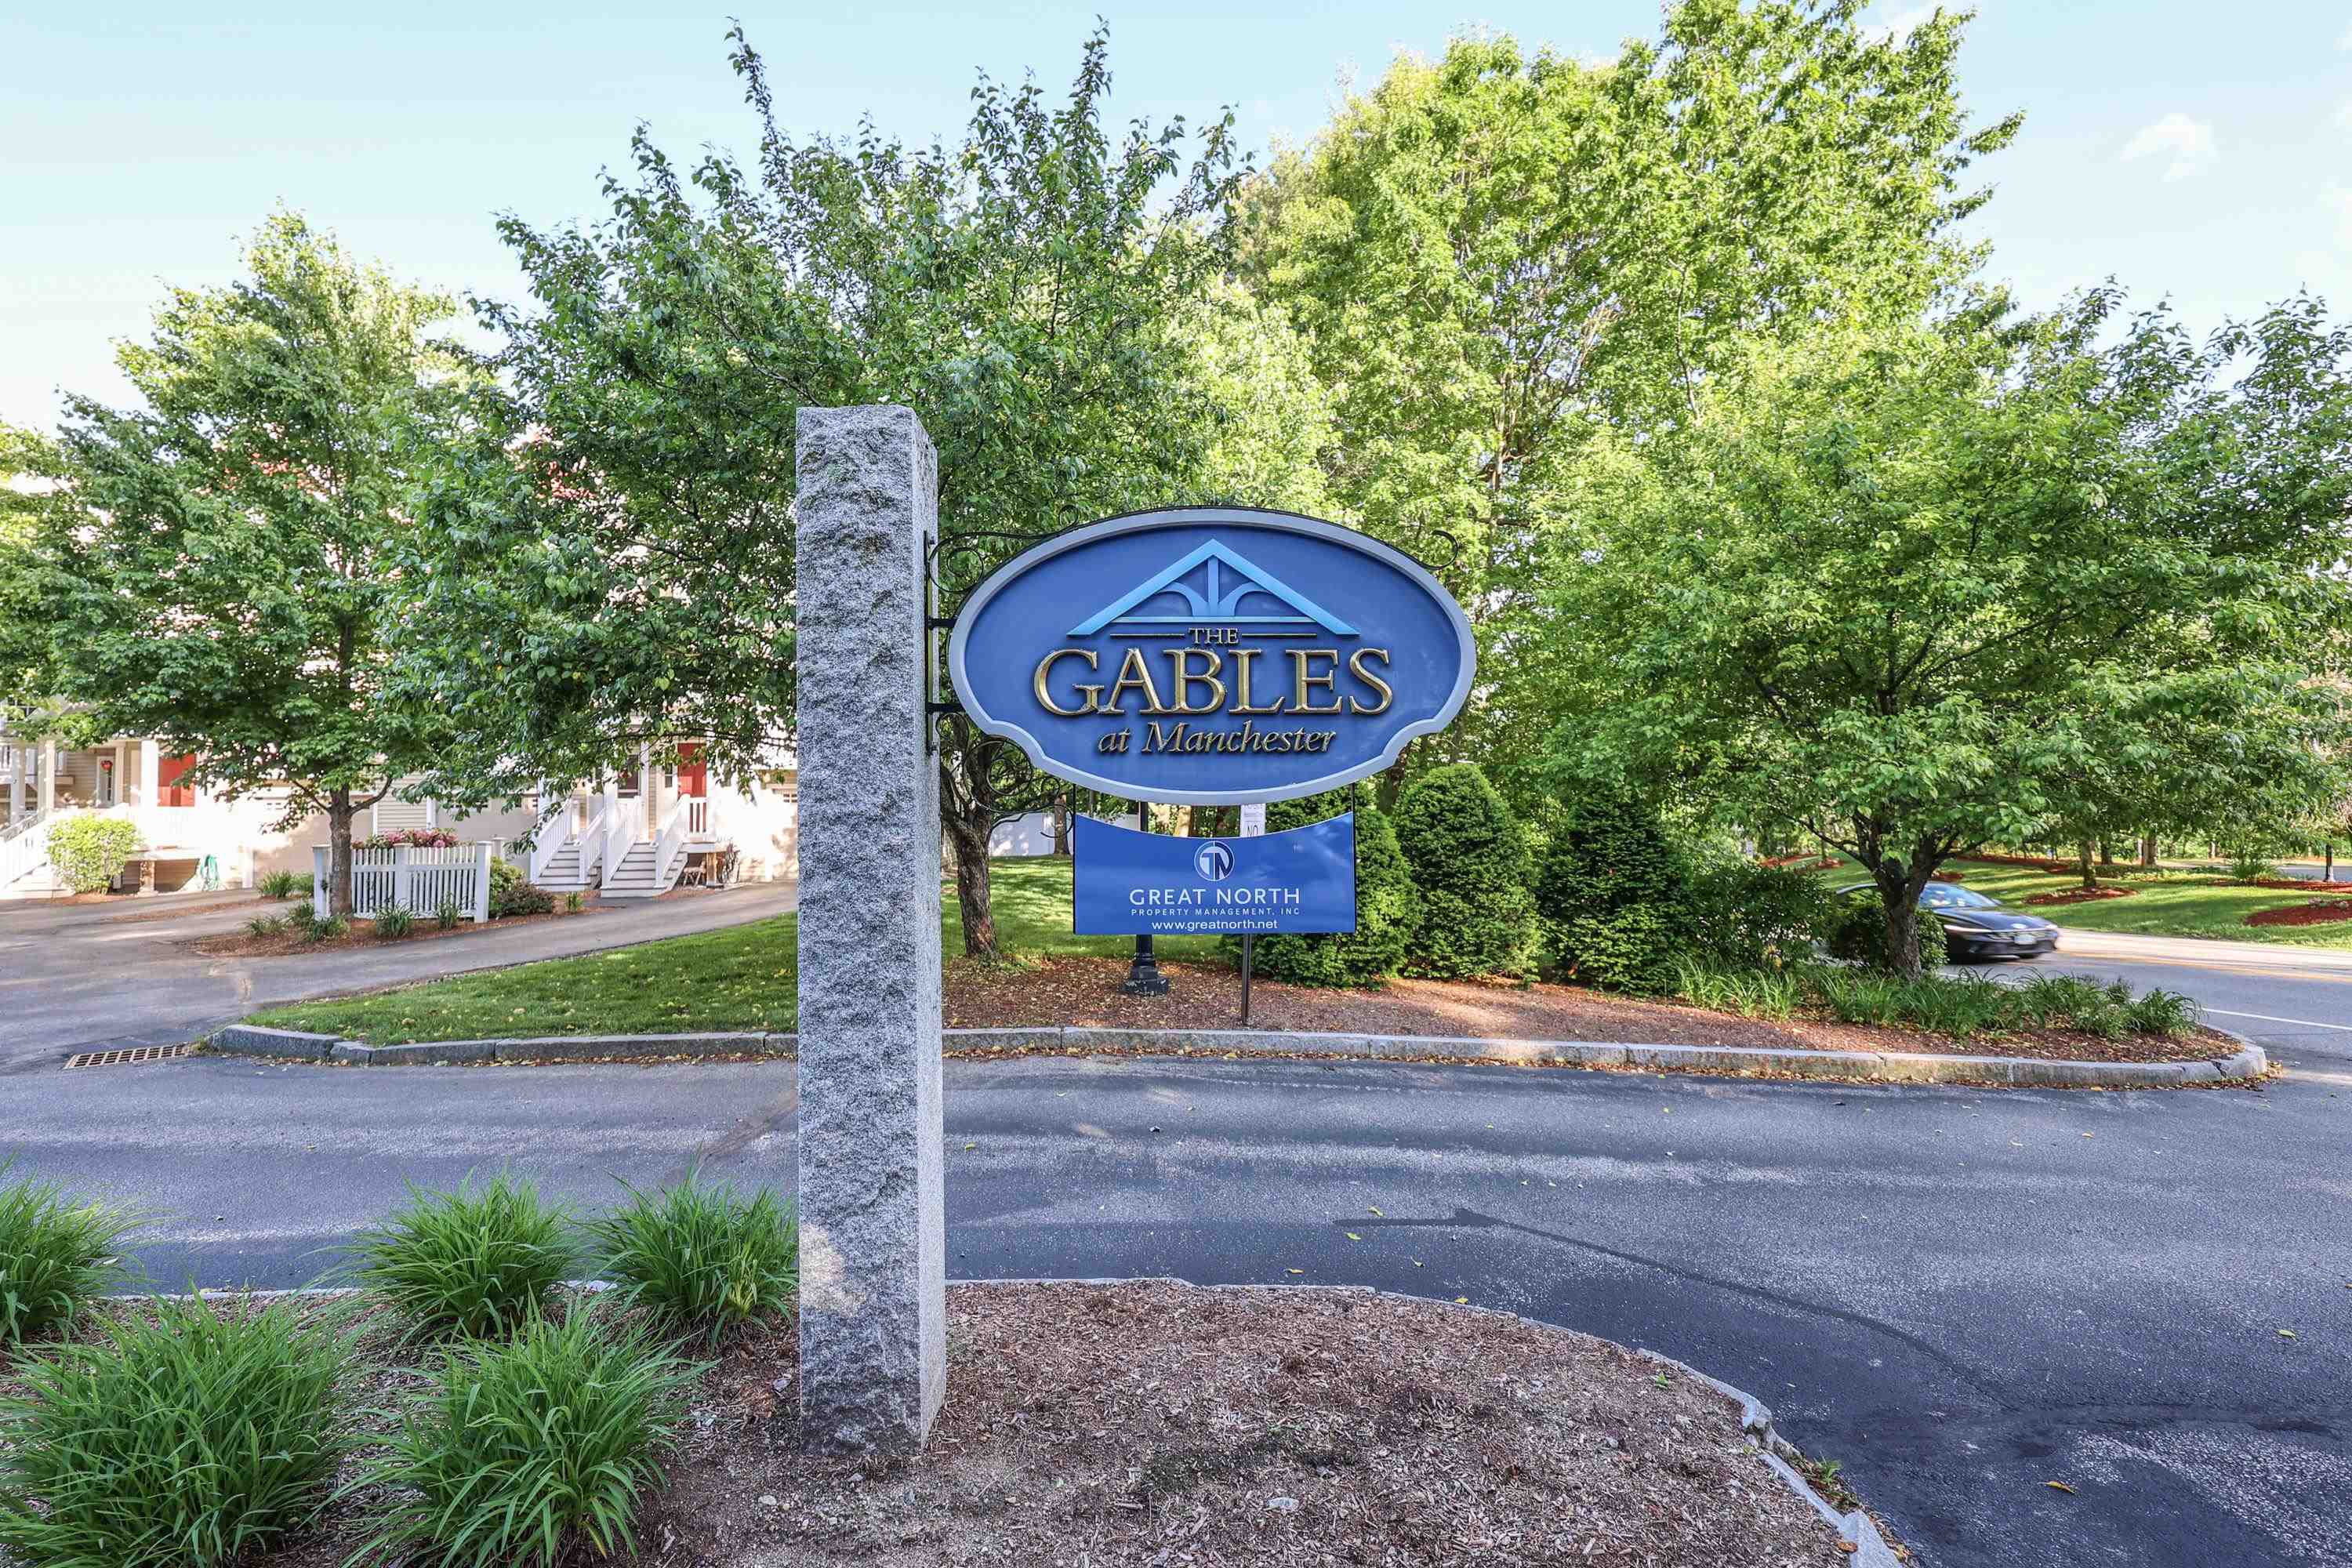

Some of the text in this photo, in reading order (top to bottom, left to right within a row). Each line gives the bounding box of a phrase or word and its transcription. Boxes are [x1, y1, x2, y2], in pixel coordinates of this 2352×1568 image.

[1187, 627, 1239, 644] THE
[1033, 648, 1393, 716] GABLES
[1098, 720, 1337, 753] at Manchester
[1129, 887, 1300, 906] GREAT NORTH
[1131, 908, 1190, 916] PROPERTY
[1280, 907, 1301, 916] INC
[1151, 919, 1279, 932] www.greatnorth.net
